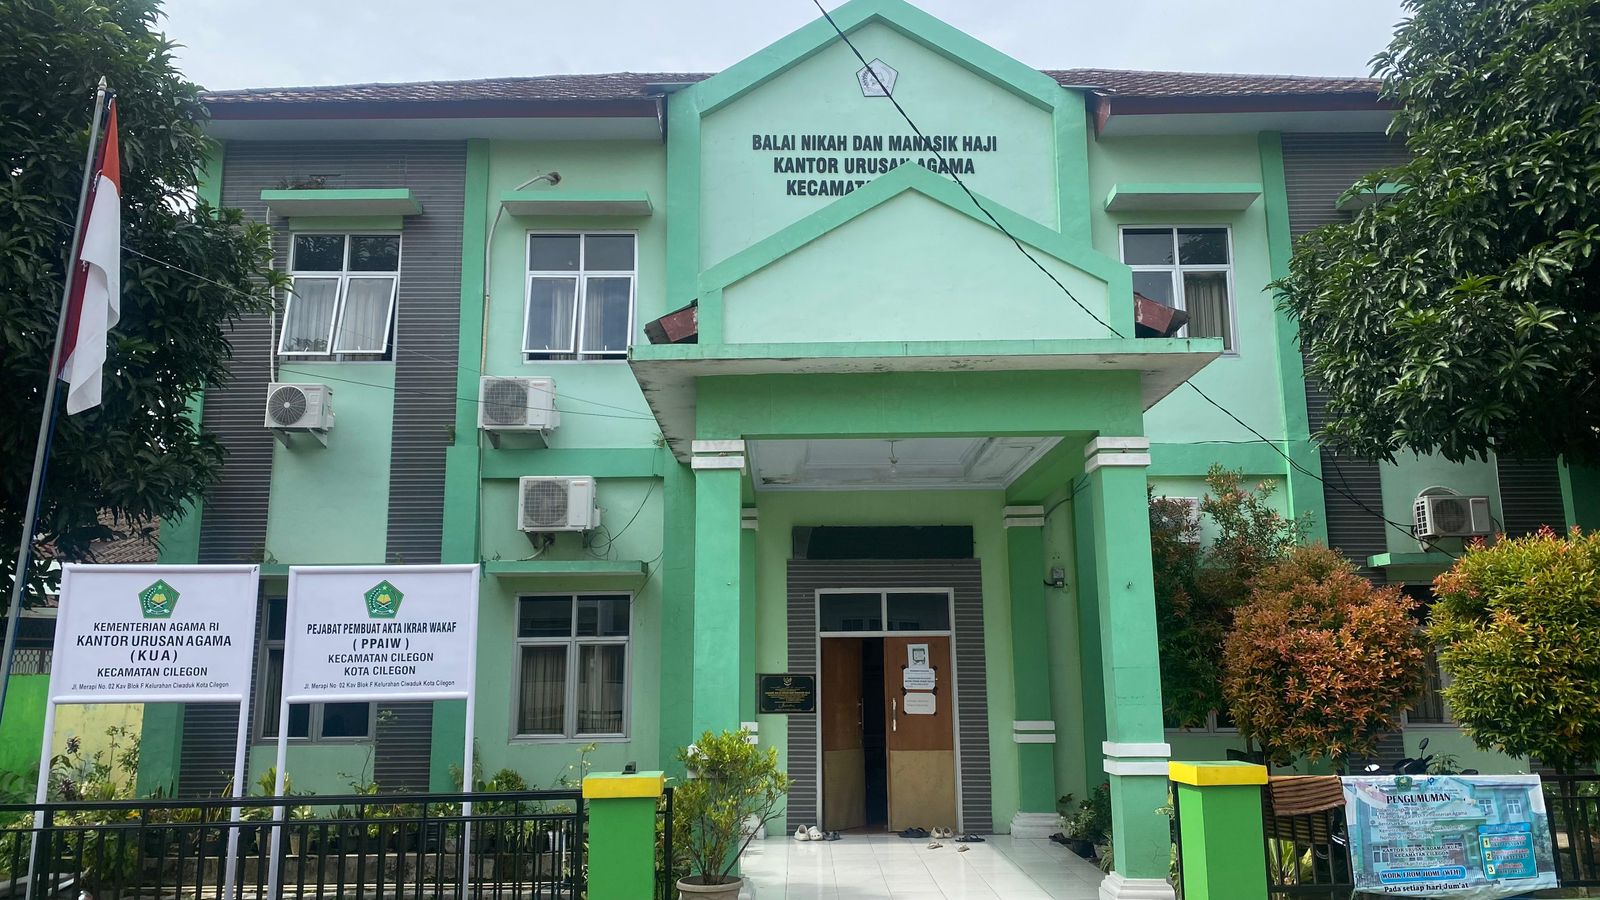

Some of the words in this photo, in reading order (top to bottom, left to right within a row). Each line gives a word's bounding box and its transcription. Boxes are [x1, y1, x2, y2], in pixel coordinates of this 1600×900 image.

[752, 134, 796, 151] BALAI
[801, 135, 847, 151] NIKAH
[853, 135, 883, 151] DAN
[888, 135, 958, 152] MANASIK
[962, 136, 997, 152] HAJI
[773, 157, 838, 174] KANTOR
[93, 622, 166, 632] KEMENTERIAN
[169, 622, 206, 631] AGAMA
[209, 622, 219, 631] RI
[306, 623, 342, 635] PEJABAT
[343, 623, 380, 634] PEMBUAT
[382, 622, 402, 634] AKTA
[403, 622, 427, 633] IKRAR
[429, 622, 457, 633] WAKAF
[76, 635, 128, 647] KANTOR
[131, 635, 184, 647] URUSAN
[185, 635, 232, 647] AGAMA
[328, 653, 388, 664] KECAMATAN
[390, 652, 434, 662] CILEGON
[97, 667, 160, 677] KECAMATAN
[163, 667, 208, 677] CILEGON
[344, 666, 370, 676] KOTA
[372, 665, 416, 675] CILEGON
[209, 681, 229, 689] Cilegon
[435, 679, 455, 687] Cilegon
[1386, 793, 1451, 805] PENGUMUMAN
[1384, 885, 1402, 893] Pada
[1402, 884, 1425, 892] setiap
